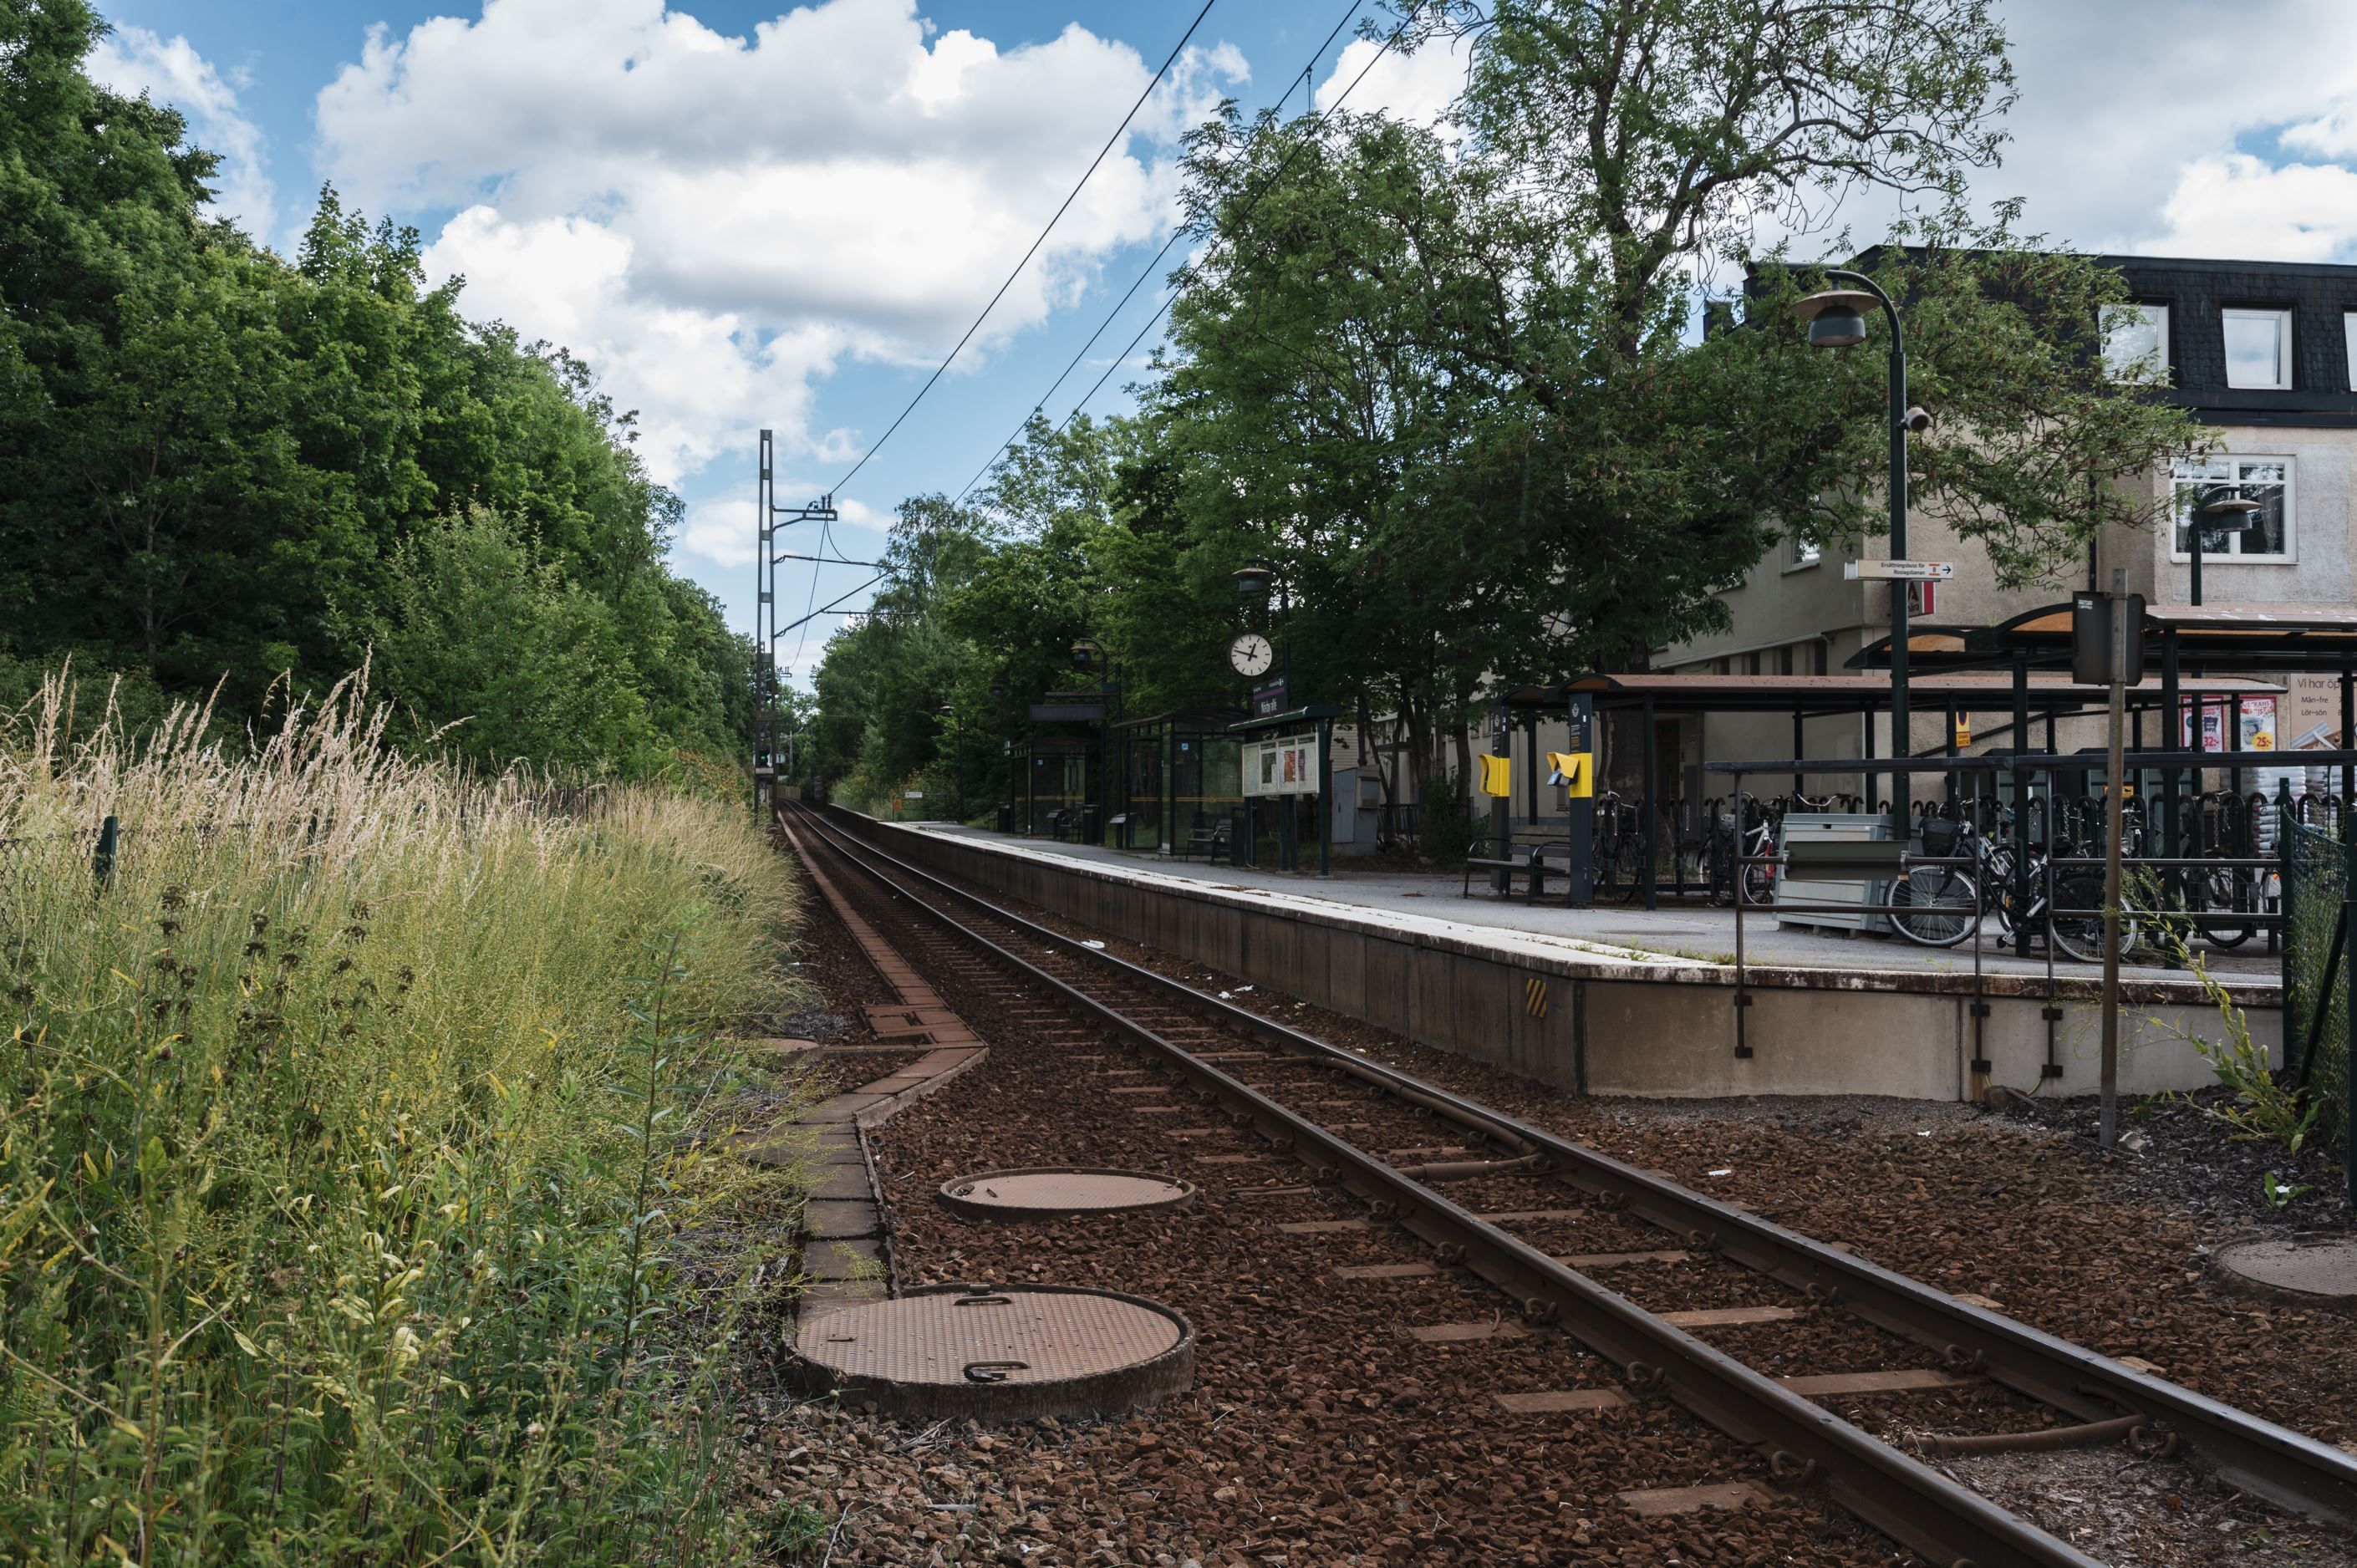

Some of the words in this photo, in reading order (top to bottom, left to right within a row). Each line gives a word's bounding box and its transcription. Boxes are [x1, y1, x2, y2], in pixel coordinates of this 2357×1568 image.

[2297, 678, 2307, 688] Vi
[2309, 678, 2325, 689] har
[2257, 736, 2272, 747] 25:-
